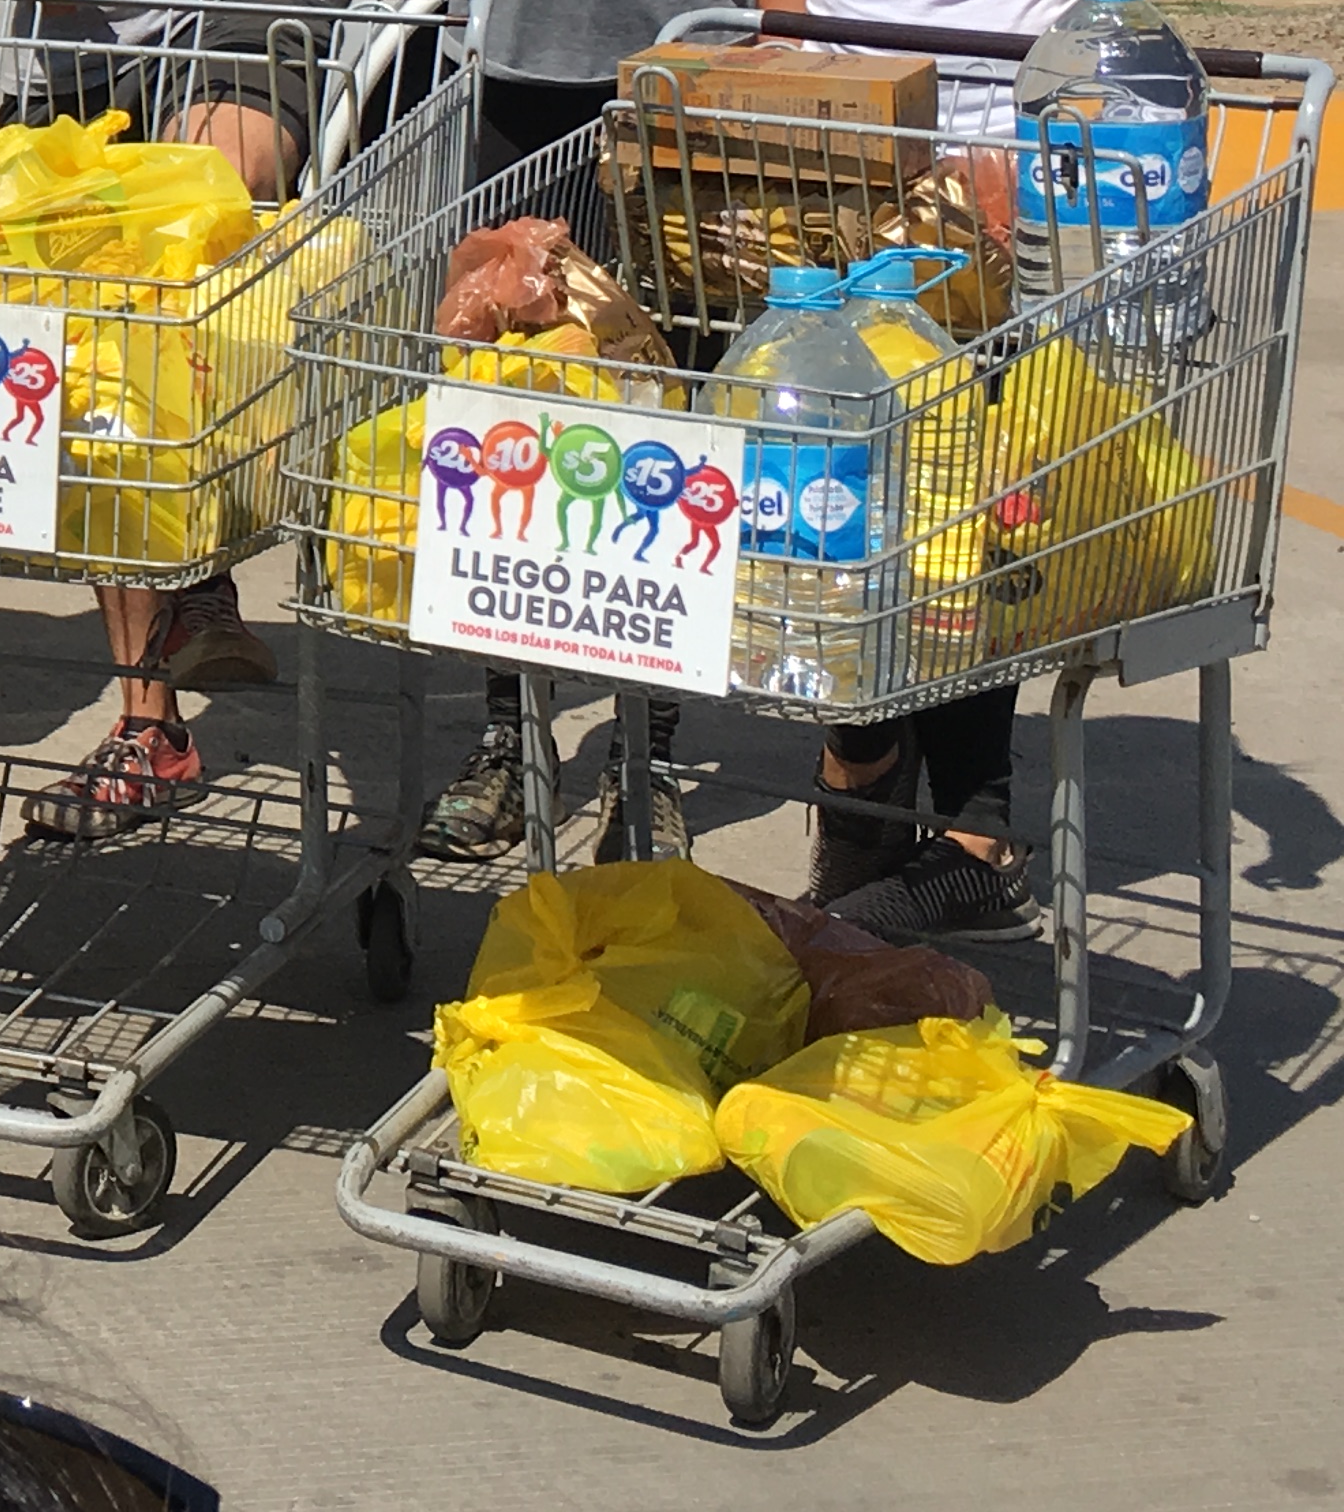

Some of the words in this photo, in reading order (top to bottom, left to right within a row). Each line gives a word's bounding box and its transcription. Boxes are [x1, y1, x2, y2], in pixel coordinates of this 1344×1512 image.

[1120, 163, 1166, 188] cel
[488, 437, 539, 471] $10
[563, 441, 611, 485] $5
[626, 457, 676, 495] $15
[741, 490, 783, 516] cel
[451, 548, 571, 594] LLEGÓ
[583, 570, 688, 616] PARA
[468, 587, 673, 649] QUEDARSE
[452, 621, 492, 639] TODOS
[495, 629, 517, 643] LOS
[521, 632, 551, 649] DÍAS
[554, 640, 580, 654] POR
[583, 645, 616, 661] TODA
[619, 651, 633, 664] LA
[637, 653, 682, 673] TIENDA
